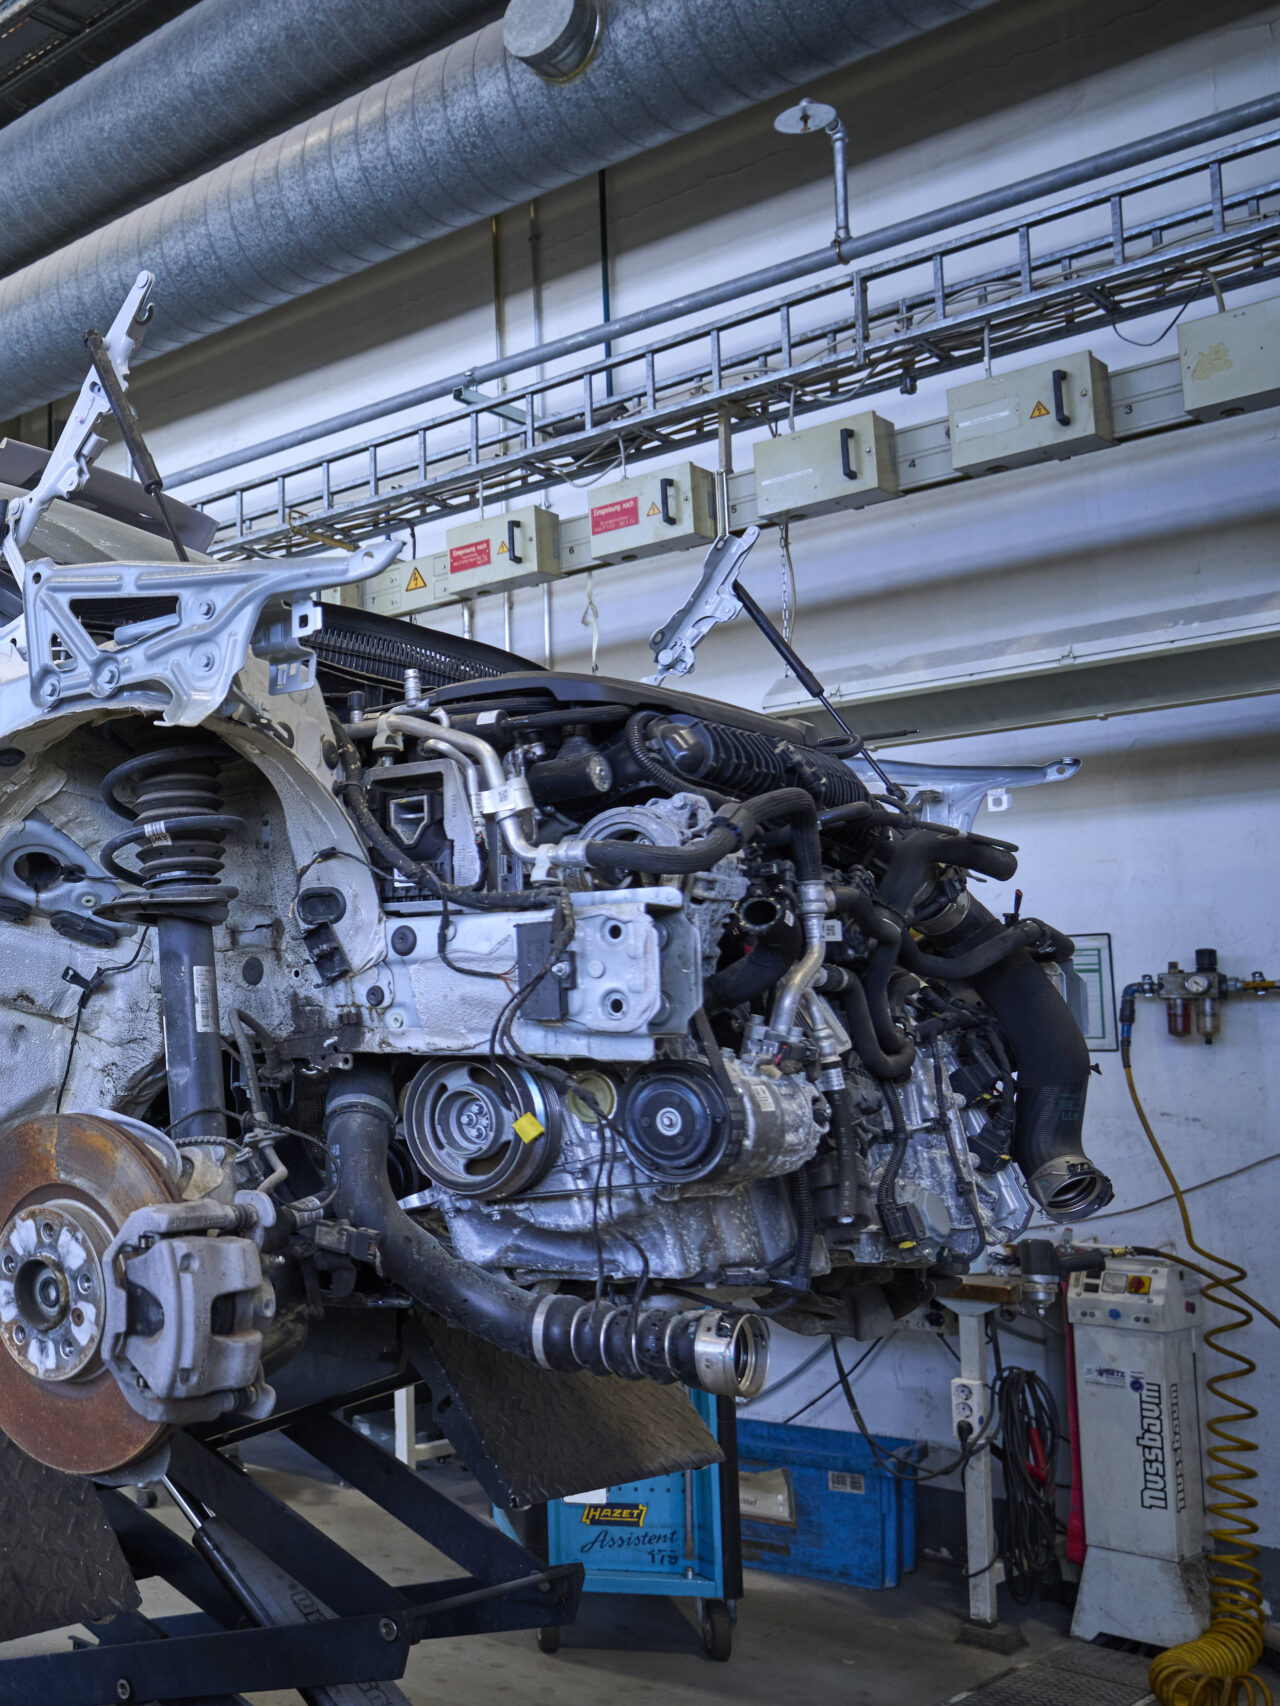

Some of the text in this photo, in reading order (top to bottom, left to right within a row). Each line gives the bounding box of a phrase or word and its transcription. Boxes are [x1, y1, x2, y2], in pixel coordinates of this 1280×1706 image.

[1124, 405, 1133, 415] 3
[569, 546, 575, 555] 6
[588, 1507, 640, 1520] HAZET
[580, 1529, 678, 1553] Assistent
